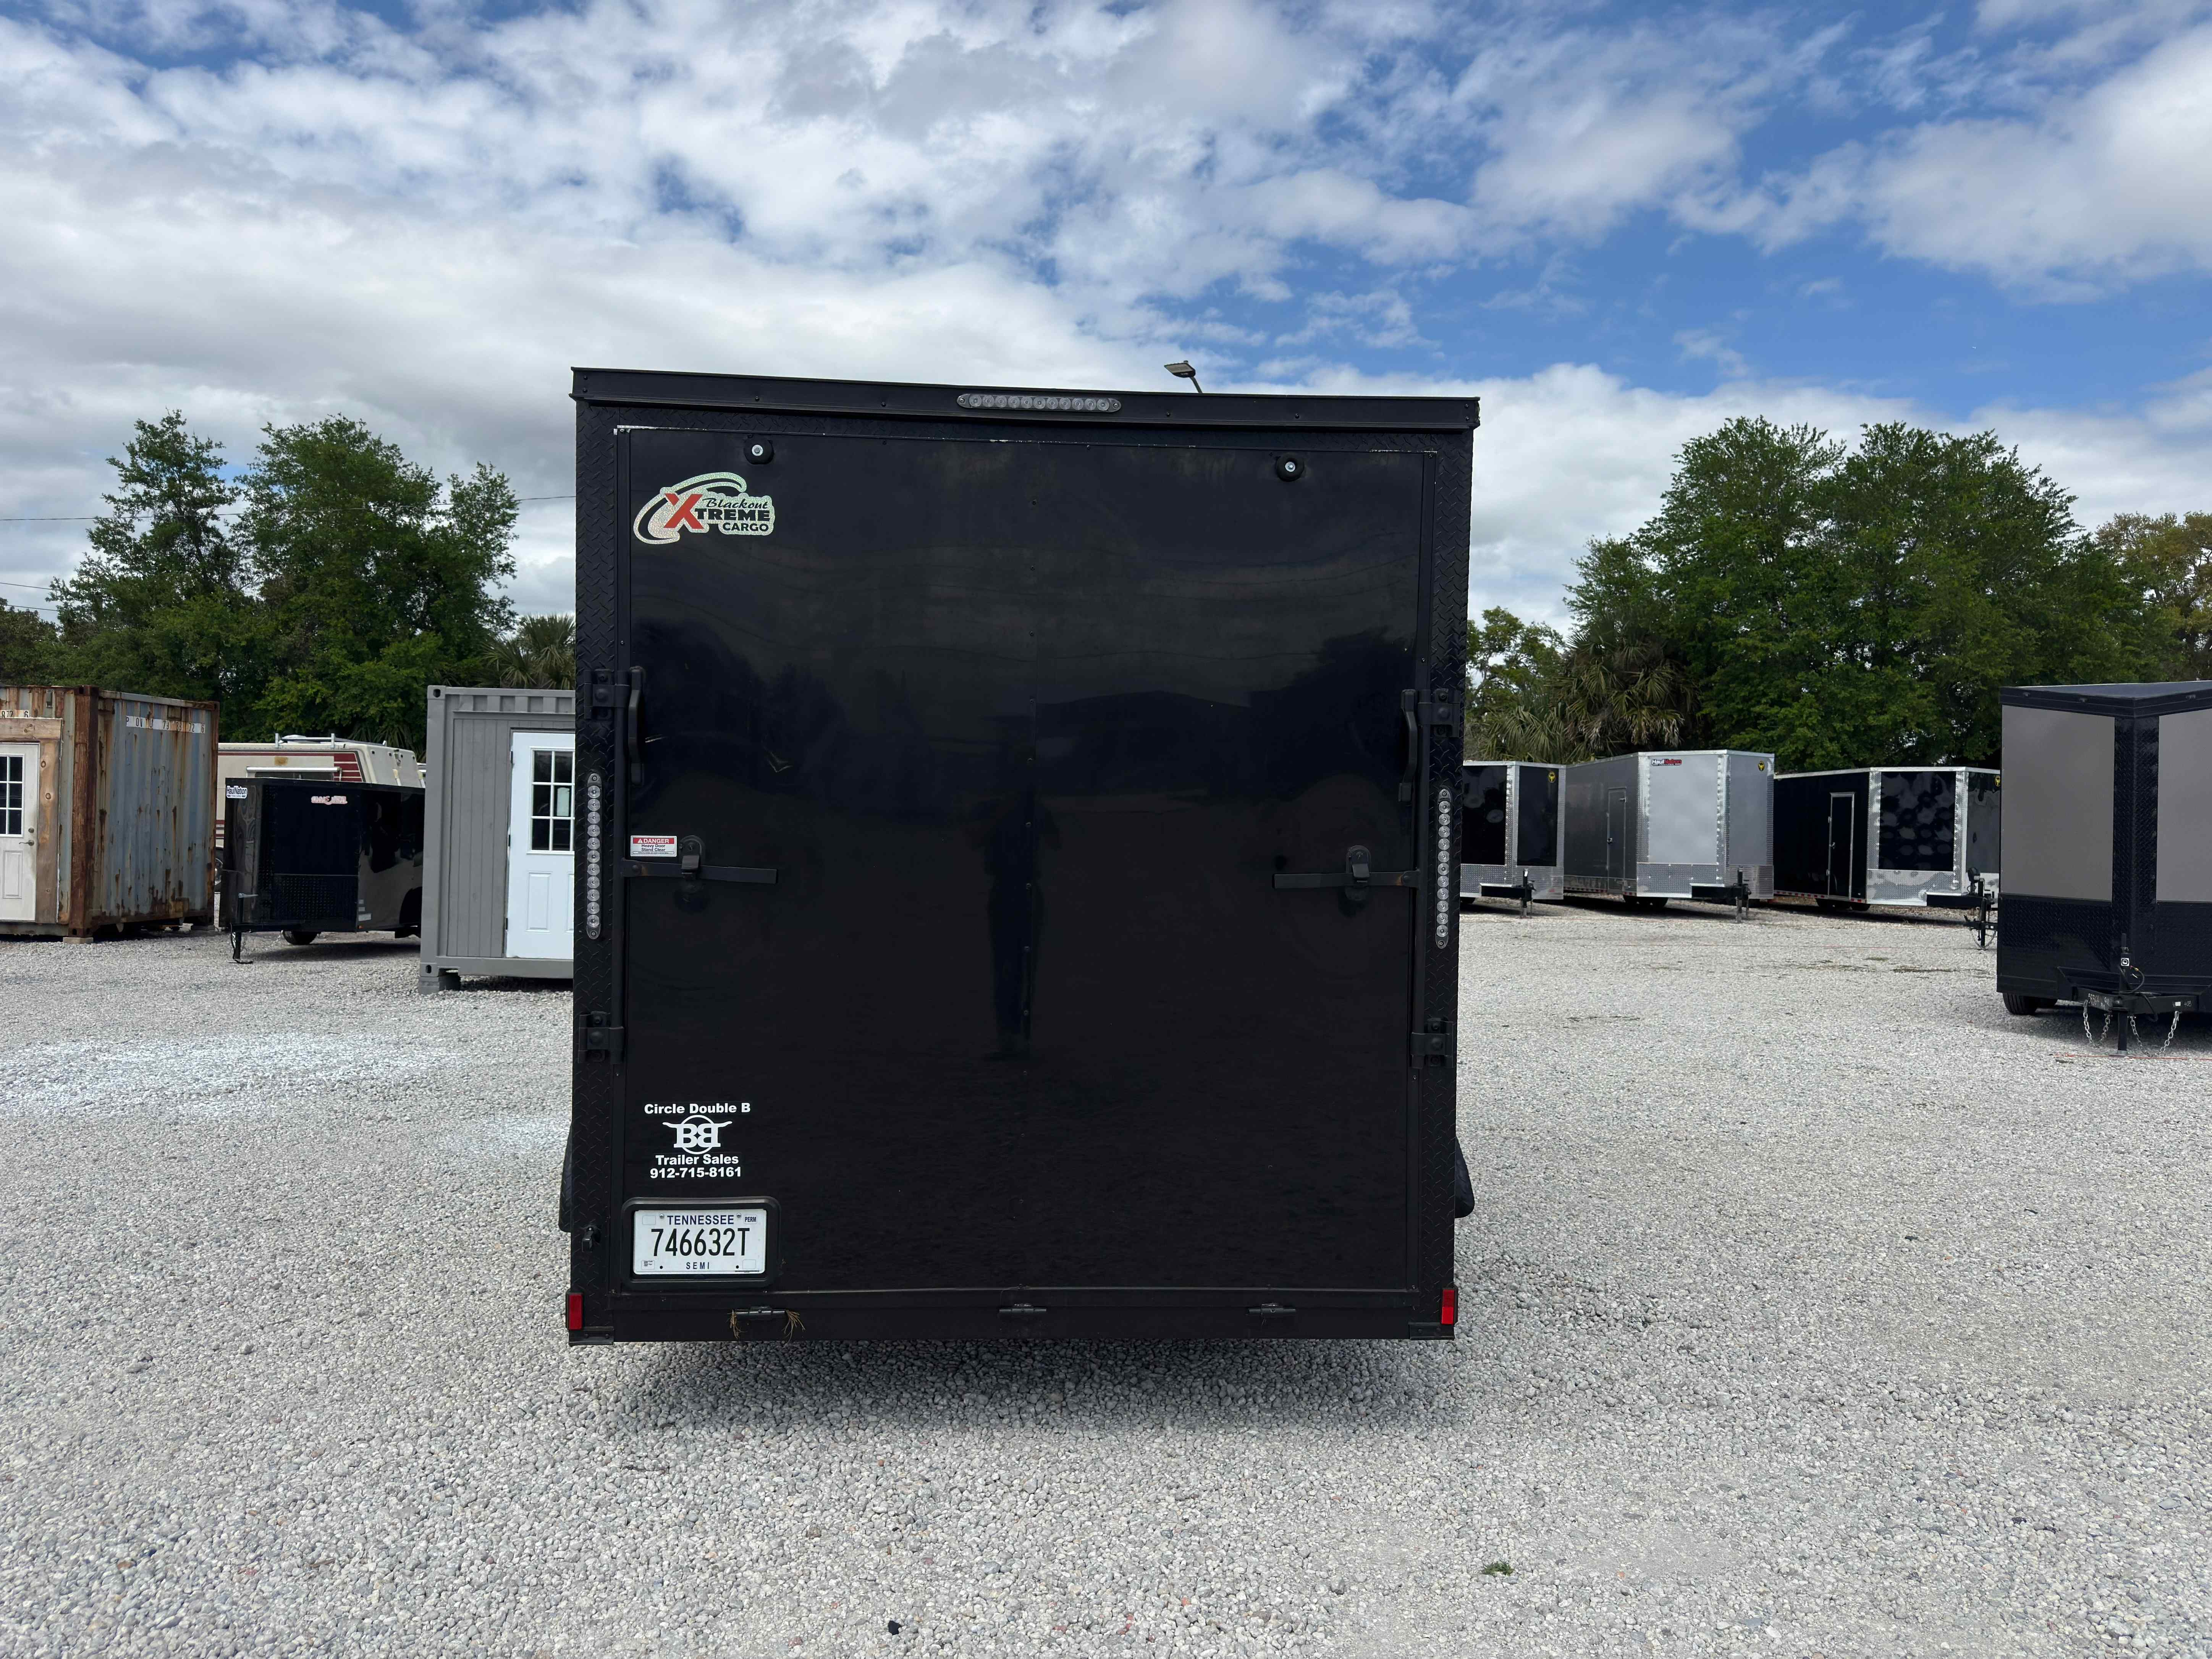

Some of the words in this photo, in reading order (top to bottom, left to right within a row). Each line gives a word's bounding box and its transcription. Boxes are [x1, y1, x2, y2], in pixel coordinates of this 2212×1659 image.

[702, 498, 768, 508] Blackout
[663, 493, 770, 529] XTREME
[723, 523, 769, 532] CARGO
[644, 1104, 685, 1114] Circle
[690, 1103, 737, 1113] Double
[742, 1103, 750, 1112] B
[655, 1155, 699, 1165] Trailer
[703, 1154, 739, 1164] Sales
[650, 1167, 741, 1179] 912-715-8161
[667, 1215, 734, 1225] TENNESSEE
[651, 1228, 750, 1256] 746632T
